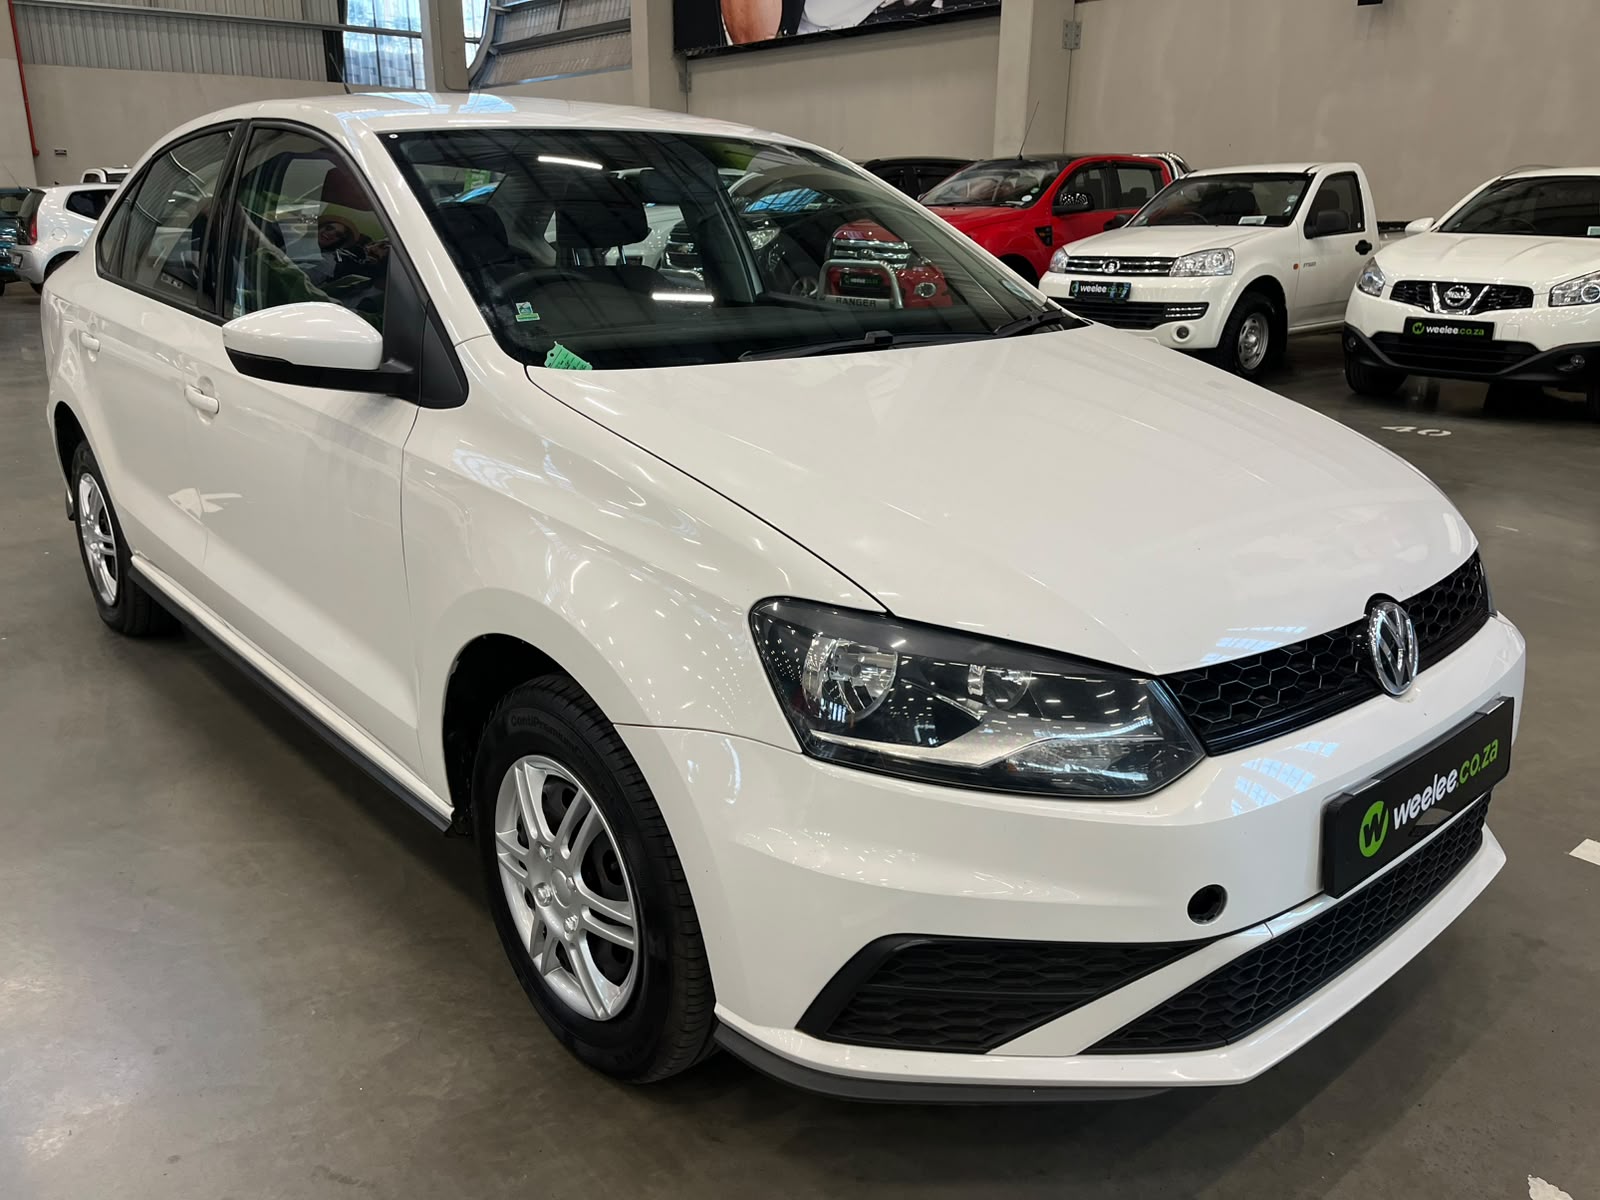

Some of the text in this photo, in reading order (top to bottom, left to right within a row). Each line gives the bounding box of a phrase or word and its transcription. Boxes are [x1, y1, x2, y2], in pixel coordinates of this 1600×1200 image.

[836, 298, 876, 308] RANGER
[1426, 325, 1485, 336] weelee.co.za
[1381, 426, 1452, 437] 40
[1393, 738, 1499, 830] weelee.co.za
